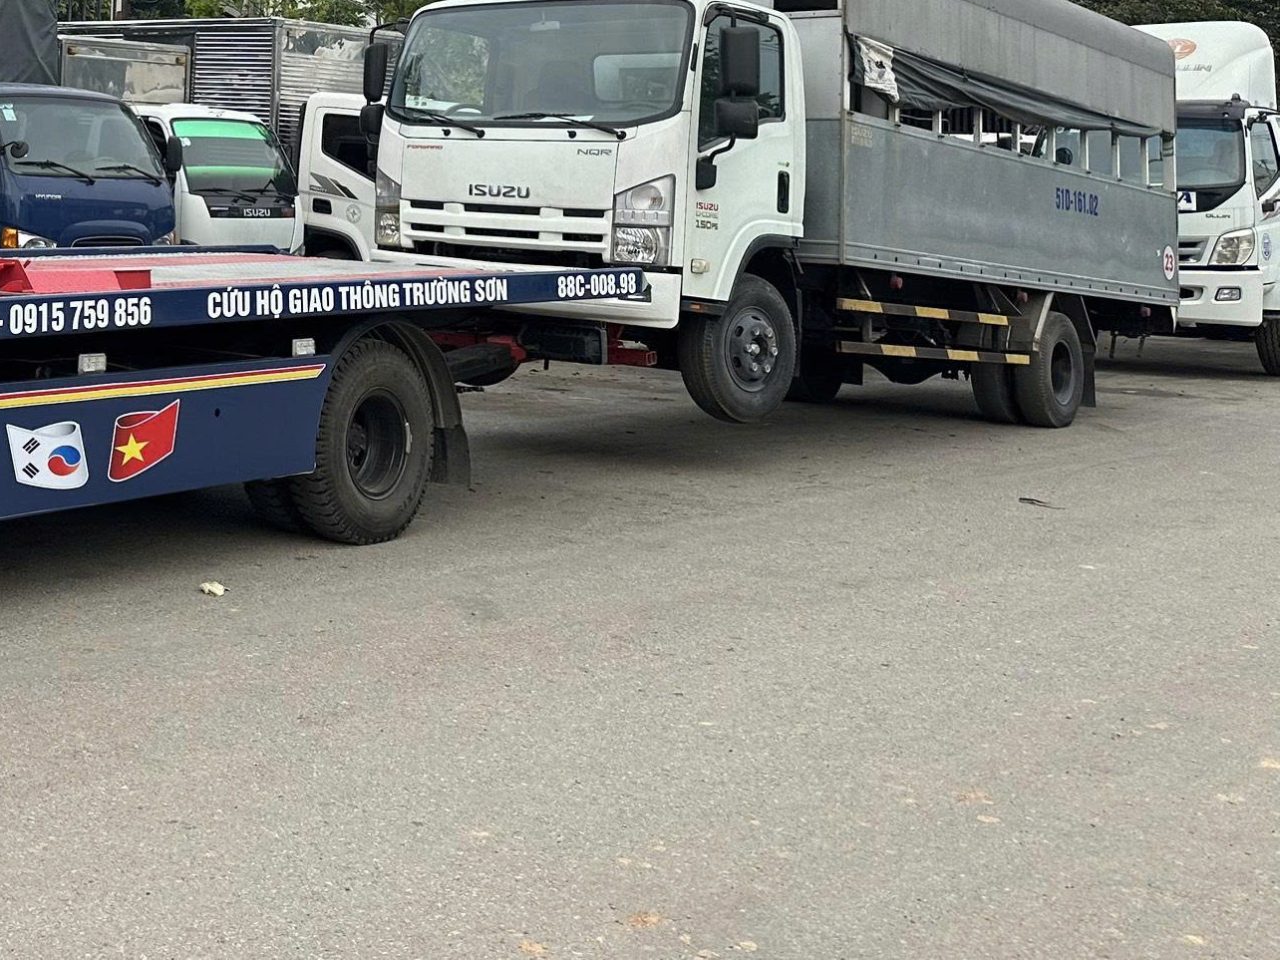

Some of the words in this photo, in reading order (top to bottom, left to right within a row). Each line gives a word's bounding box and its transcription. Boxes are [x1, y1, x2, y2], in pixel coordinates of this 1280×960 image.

[577, 148, 613, 157] NQR
[468, 183, 531, 199] ISUZU
[696, 202, 719, 212] ISUZU
[1055, 187, 1099, 217] 51D-161.02
[243, 209, 271, 217] ISUZU
[1164, 253, 1173, 272] 23
[556, 272, 637, 298] 88C-008.98
[207, 286, 251, 319] CỨU
[255, 283, 284, 319] HỘ
[288, 286, 335, 314] GIAO
[338, 279, 400, 311] THÔNG
[402, 276, 471, 308] TRƯỜNG
[474, 276, 509, 302] SƠN
[9, 301, 65, 335] 0915
[69, 298, 110, 331] 759
[114, 296, 152, 328] 856
